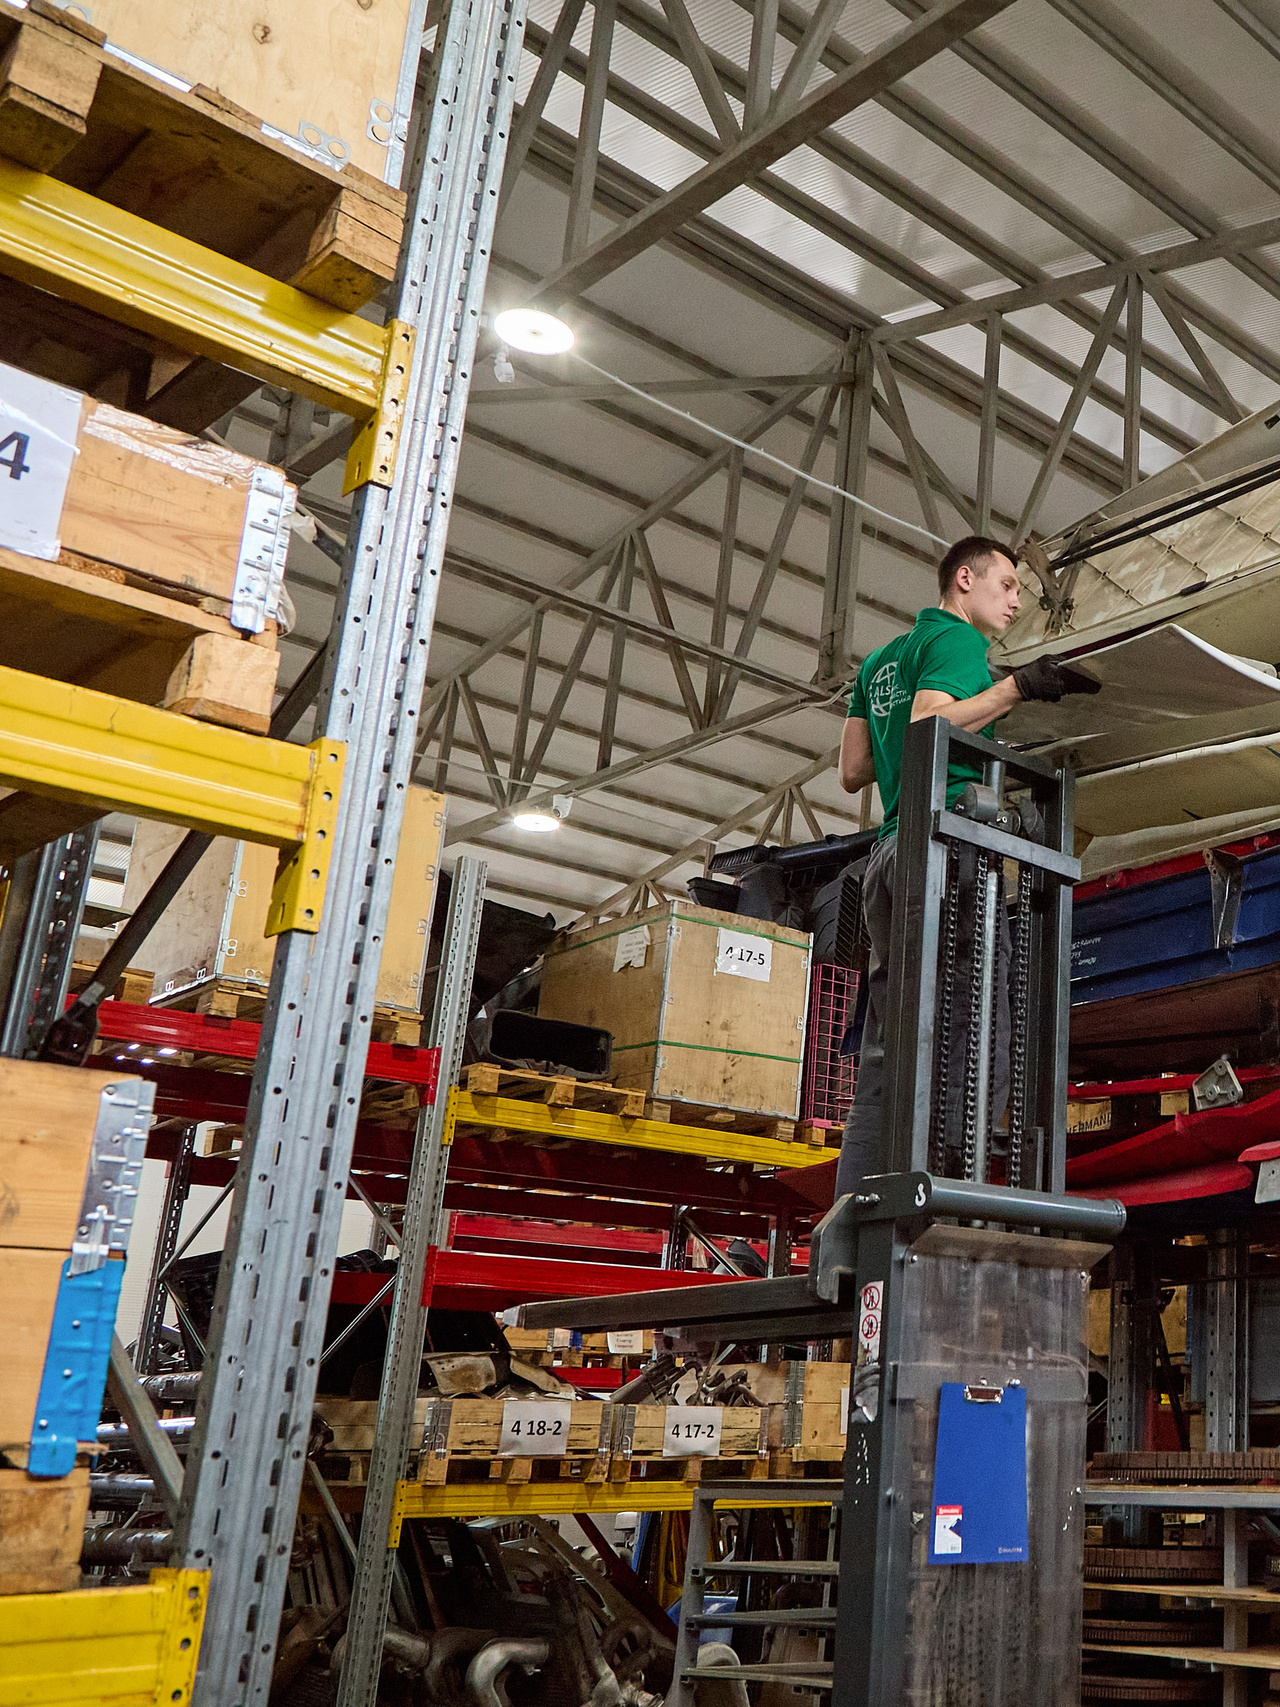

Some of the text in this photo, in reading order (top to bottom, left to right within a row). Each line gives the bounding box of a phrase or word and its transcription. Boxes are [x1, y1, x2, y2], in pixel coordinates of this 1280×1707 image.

[738, 949, 766, 966] 17-5
[511, 1420, 562, 1436] 4 18-2
[672, 1424, 715, 1438] 4 17-2
